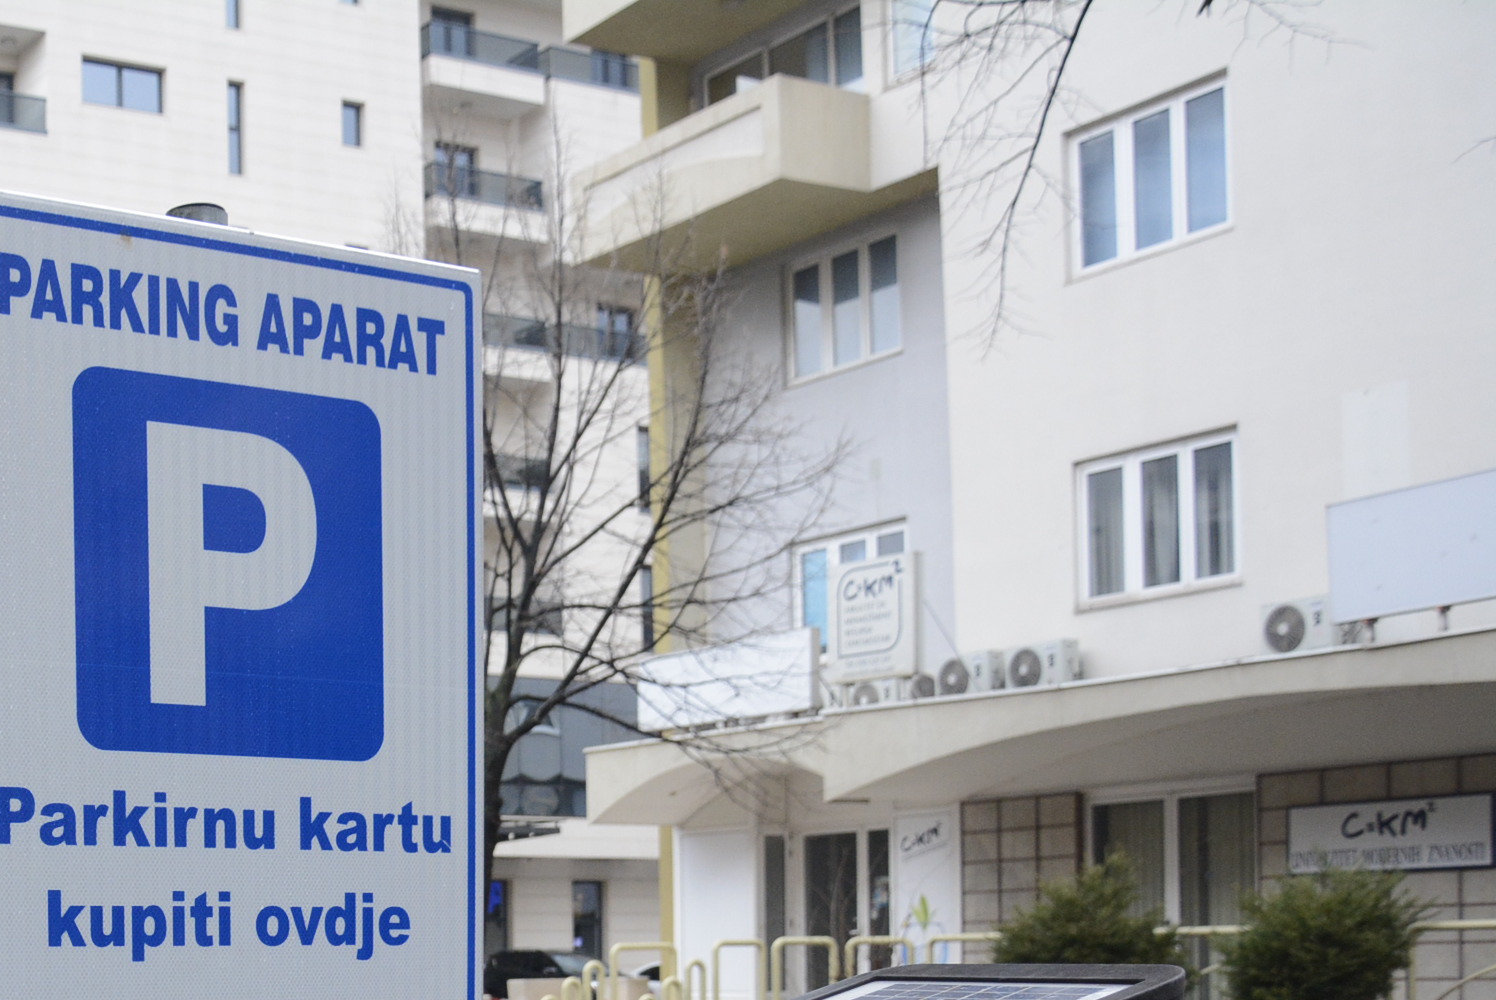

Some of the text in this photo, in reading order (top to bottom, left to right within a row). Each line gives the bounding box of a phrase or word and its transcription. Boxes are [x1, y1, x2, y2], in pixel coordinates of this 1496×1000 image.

[256, 293, 446, 376] APARAT
[146, 421, 318, 707] P
[299, 796, 452, 854] kartu
[47, 889, 411, 962] kupiti ovdje
